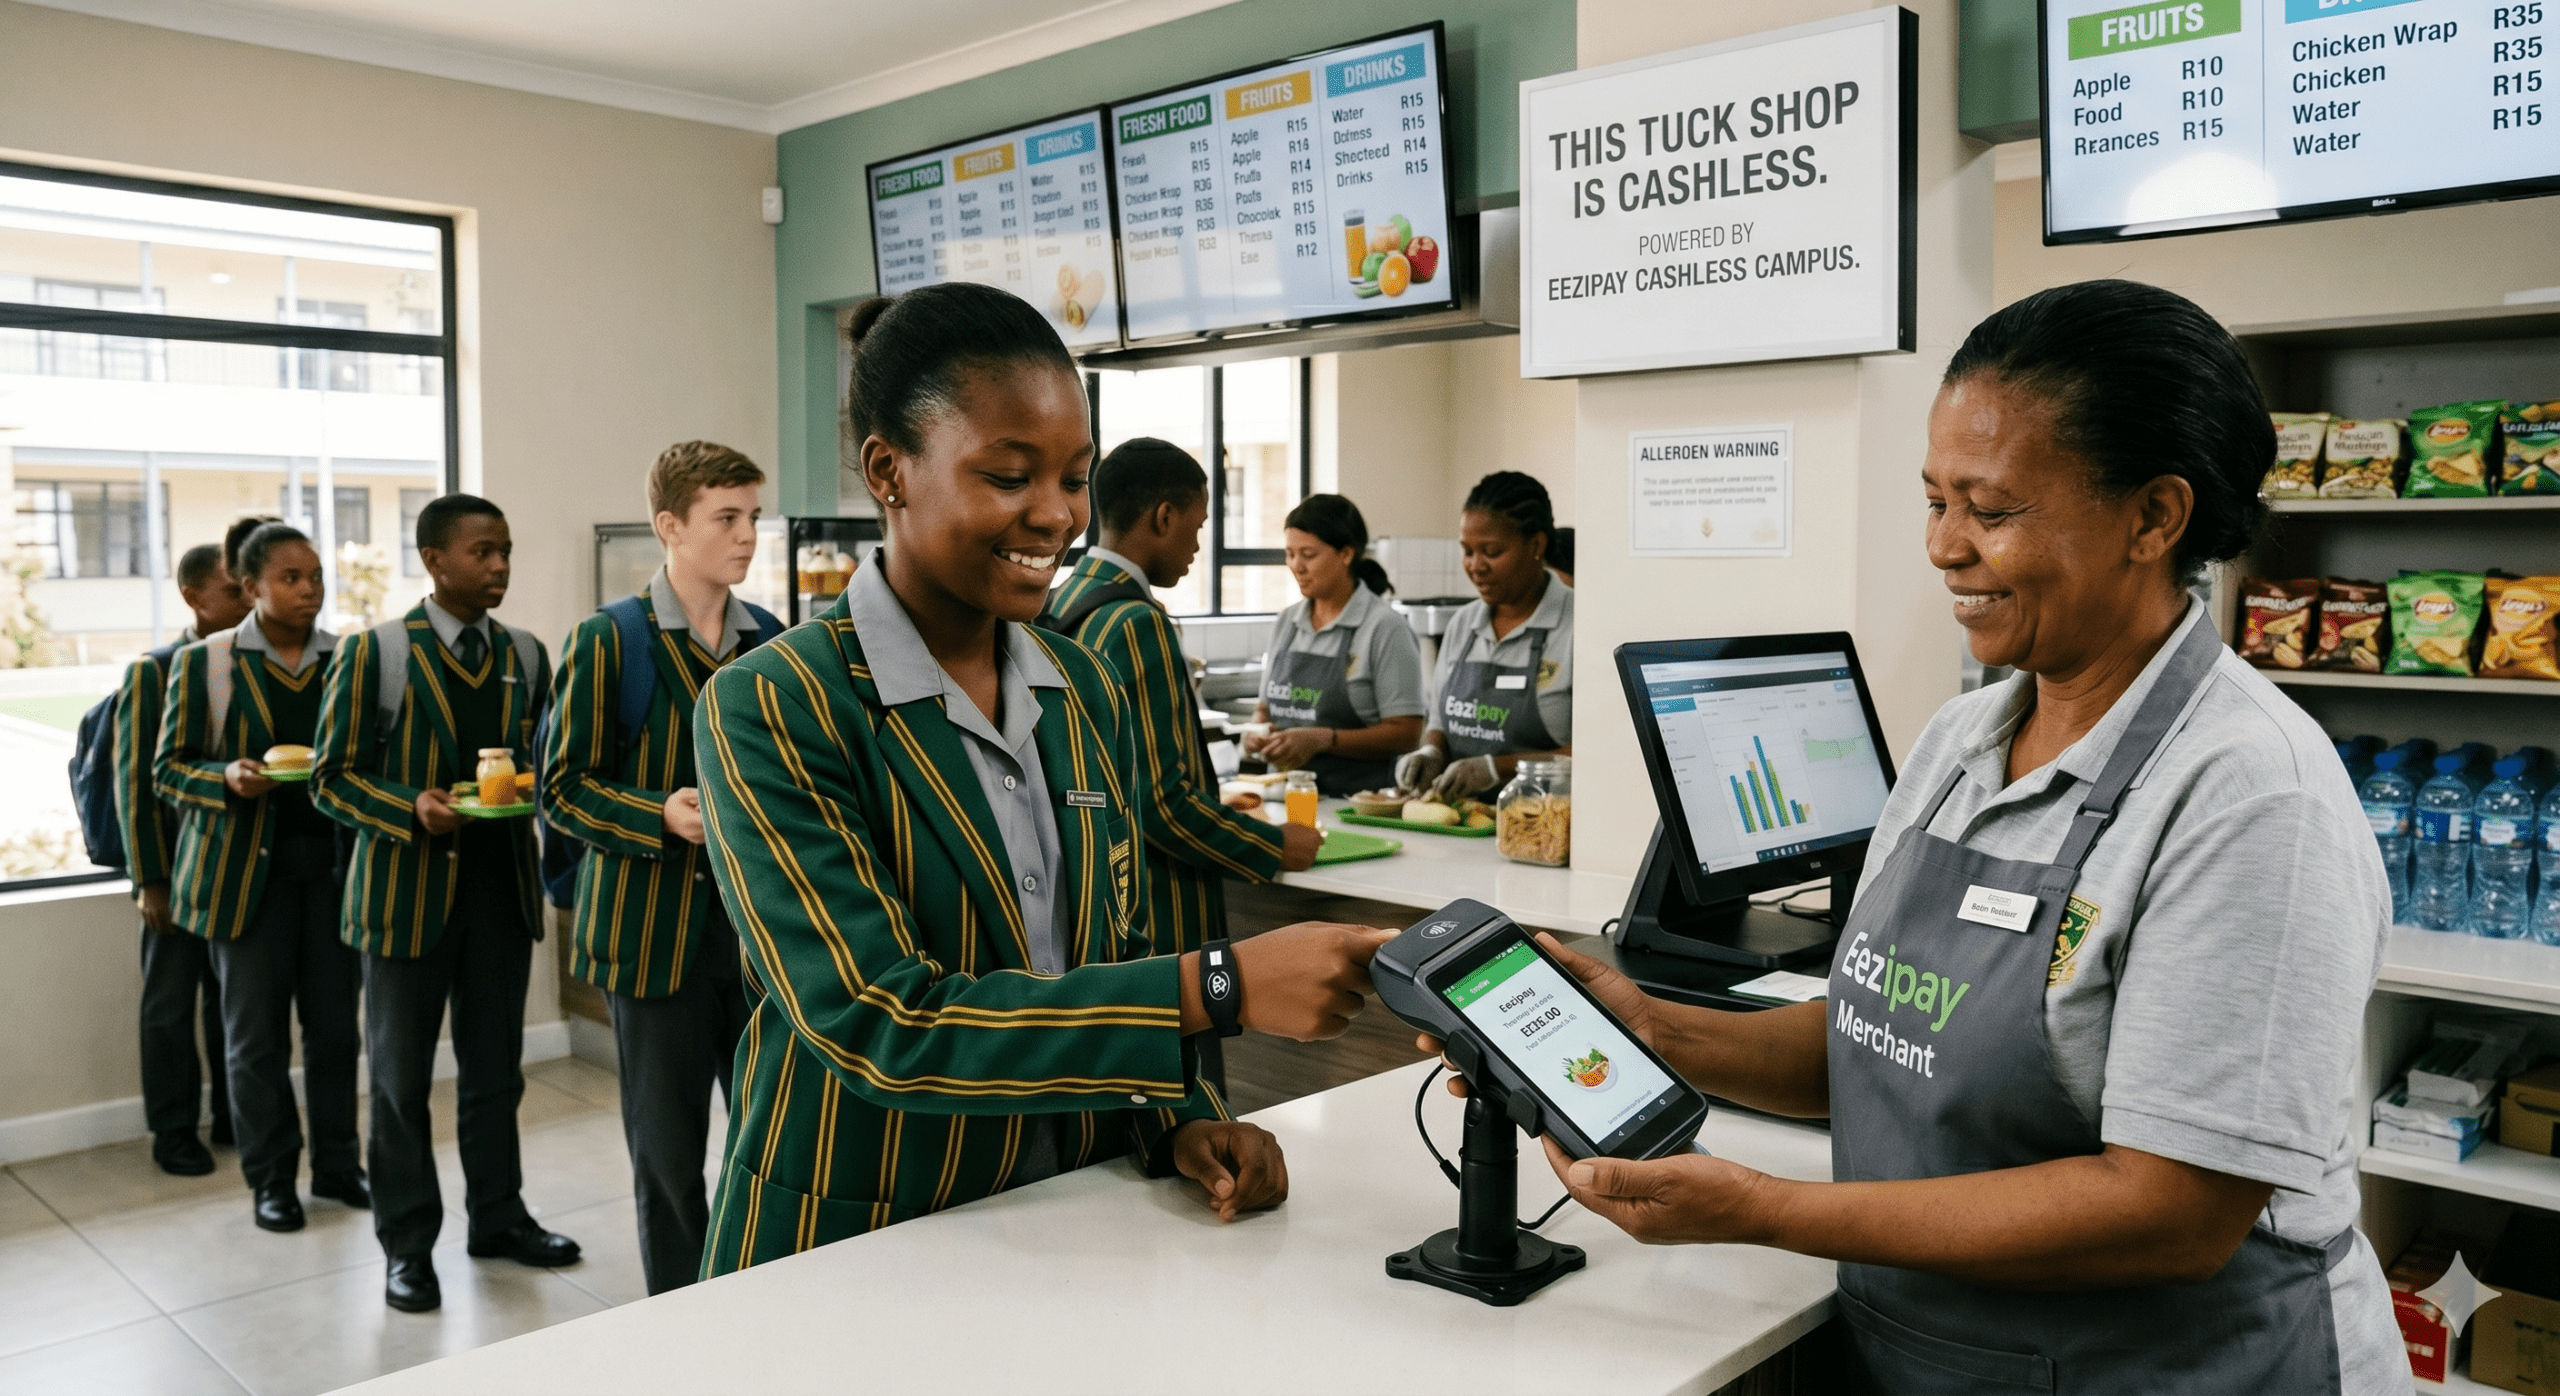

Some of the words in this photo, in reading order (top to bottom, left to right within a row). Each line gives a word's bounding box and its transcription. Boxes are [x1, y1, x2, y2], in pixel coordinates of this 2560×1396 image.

[2102, 2, 2204, 47] FRUITS
[2292, 33, 2385, 62] Chicken
[2394, 21, 2458, 46] Wrap
[2494, 2, 2543, 29] R35
[1344, 54, 1406, 87] DRINKS
[2073, 72, 2130, 100] Apple
[2183, 56, 2222, 80] R10
[2292, 65, 2386, 94] Chicken
[2494, 36, 2543, 63] R35
[1241, 81, 1293, 110] FRUITS
[1332, 107, 1364, 124] Water
[1401, 92, 1423, 109] R15
[2075, 102, 2122, 126] Food
[2183, 87, 2223, 110] R10
[2292, 100, 2361, 124] Water
[2493, 70, 2542, 96] R15
[1124, 111, 1166, 138] FRESH
[1170, 102, 1206, 128] FOOD
[1402, 115, 1424, 131] R15
[1549, 122, 1626, 171] THIS
[1639, 102, 1737, 156] TUCK
[1750, 81, 1860, 138] SHOP
[2183, 118, 2223, 140] R15
[2293, 132, 2361, 156] Water
[2493, 104, 2542, 130] R15
[1039, 132, 1082, 158] DRINKS
[1190, 139, 1208, 153] R15
[1231, 129, 1258, 147] Apple
[1404, 136, 1426, 153] R14
[1233, 149, 1261, 167] Apple
[1291, 158, 1311, 174] R14
[879, 176, 912, 195] FRESH
[913, 166, 941, 185] FOOD
[1292, 180, 1313, 195] R15
[1337, 171, 1373, 188] Drinks
[1406, 159, 1428, 175] R15
[1574, 178, 1605, 218] IS
[1619, 145, 1827, 212] CASHLESS.
[1294, 200, 1314, 216] R15
[1295, 221, 1316, 236] R15
[1639, 226, 1725, 256] POWERED
[1732, 222, 1754, 245] BY
[1297, 242, 1317, 258] R12
[1548, 270, 1628, 301] EEZIPAY
[1636, 256, 1747, 292] CASHLESS
[1755, 245, 1860, 278] CAMPUS.
[1714, 442, 1779, 458] WARNING
[1449, 720, 1505, 742] Merchant
[1841, 931, 1971, 1033] Eezipay
[1836, 998, 1935, 1078] Merchant
